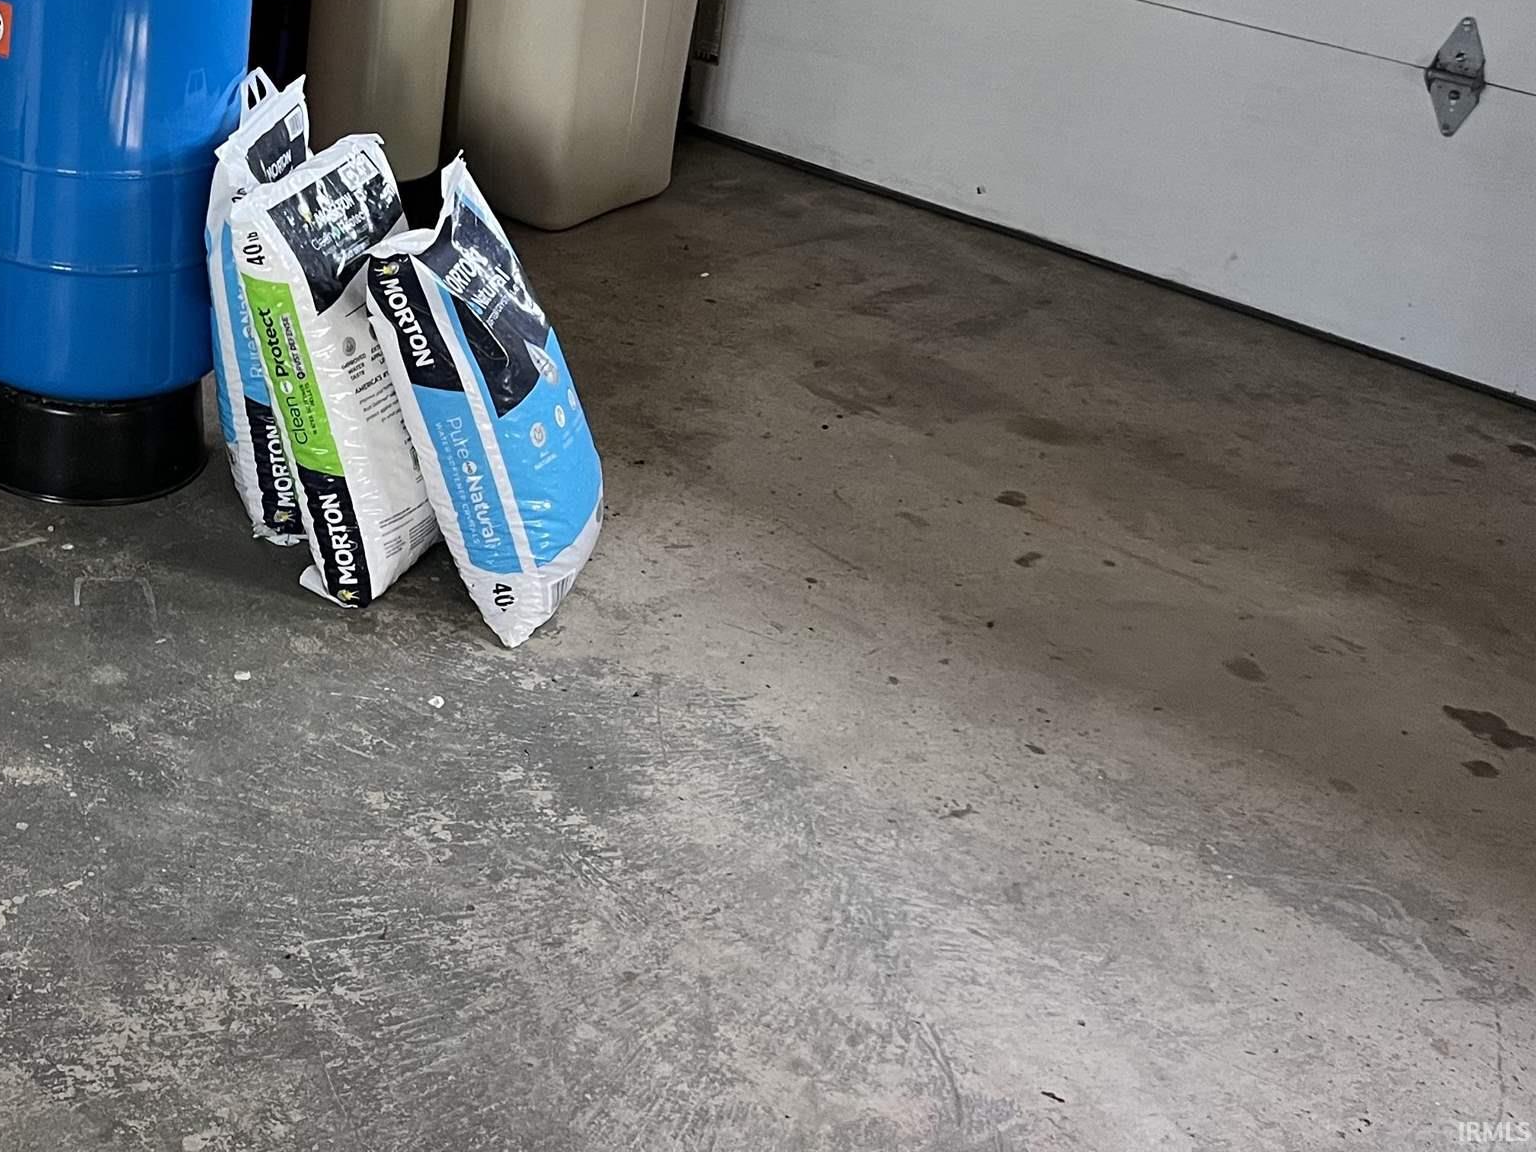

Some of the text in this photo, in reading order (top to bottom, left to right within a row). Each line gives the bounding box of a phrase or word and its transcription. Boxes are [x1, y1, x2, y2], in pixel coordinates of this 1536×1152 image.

[242, 244, 266, 266] 40
[247, 231, 259, 243] lb
[257, 307, 289, 378] Protect
[379, 278, 435, 367] MORTON
[286, 396, 309, 446] Clean
[265, 425, 296, 508] MORTON
[446, 415, 469, 459] Pure
[465, 474, 501, 549] Natural
[318, 493, 358, 586] MORTON
[492, 582, 514, 608] 40
